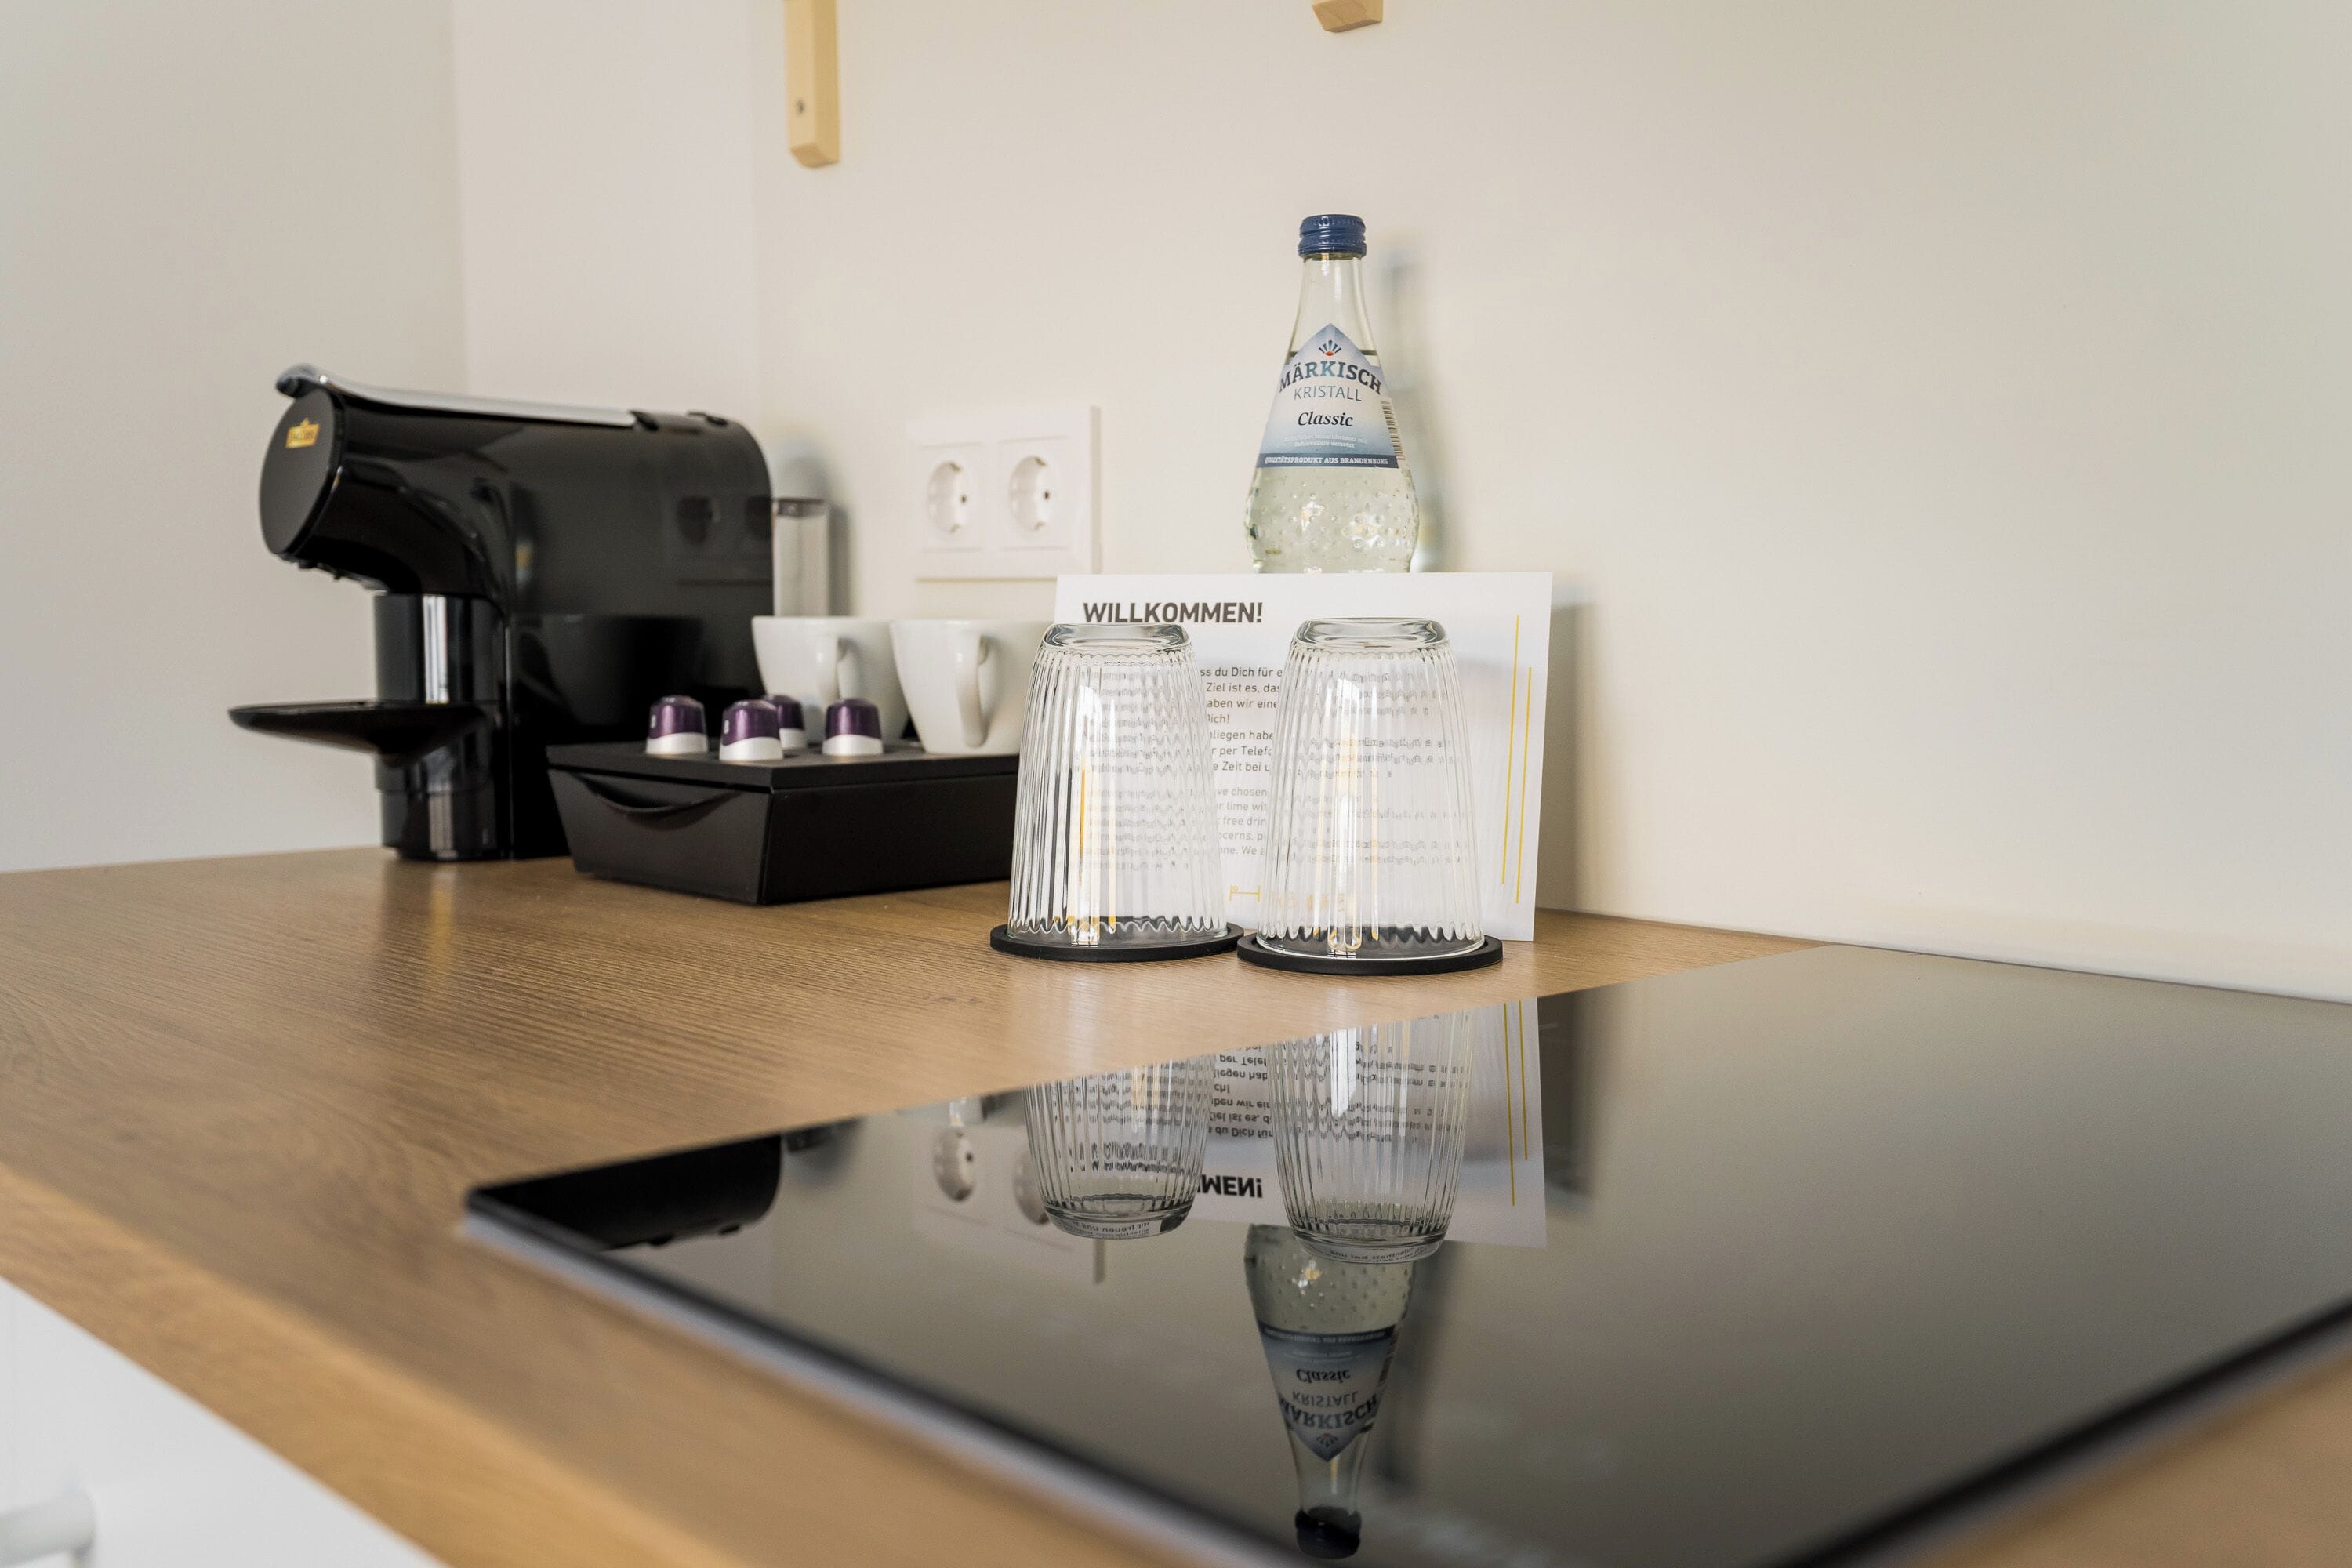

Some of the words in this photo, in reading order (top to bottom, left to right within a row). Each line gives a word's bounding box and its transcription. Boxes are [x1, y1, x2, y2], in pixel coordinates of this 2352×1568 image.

[1279, 361, 1381, 395] MÄRKISCH
[1294, 385, 1363, 401] KRISTALL
[1298, 411, 1354, 426] Classic
[1083, 602, 1263, 623] WILLKOMMEN!
[1214, 667, 1228, 677] du
[1231, 666, 1254, 677] Dich
[1258, 667, 1273, 677] für
[1206, 682, 1225, 692] Ziel
[1229, 683, 1242, 692] ist
[1245, 684, 1260, 693] es,
[1263, 683, 1280, 693] das
[1207, 699, 1232, 708] aben
[1236, 699, 1254, 708] wir
[1210, 729, 1245, 741] liegen
[1219, 747, 1237, 757] per
[1222, 761, 1242, 771] Zeit
[1246, 761, 1261, 771] bei
[1231, 787, 1267, 797] chosen
[1226, 802, 1249, 811] time
[1223, 816, 1243, 826] free
[1241, 846, 1257, 855] We
